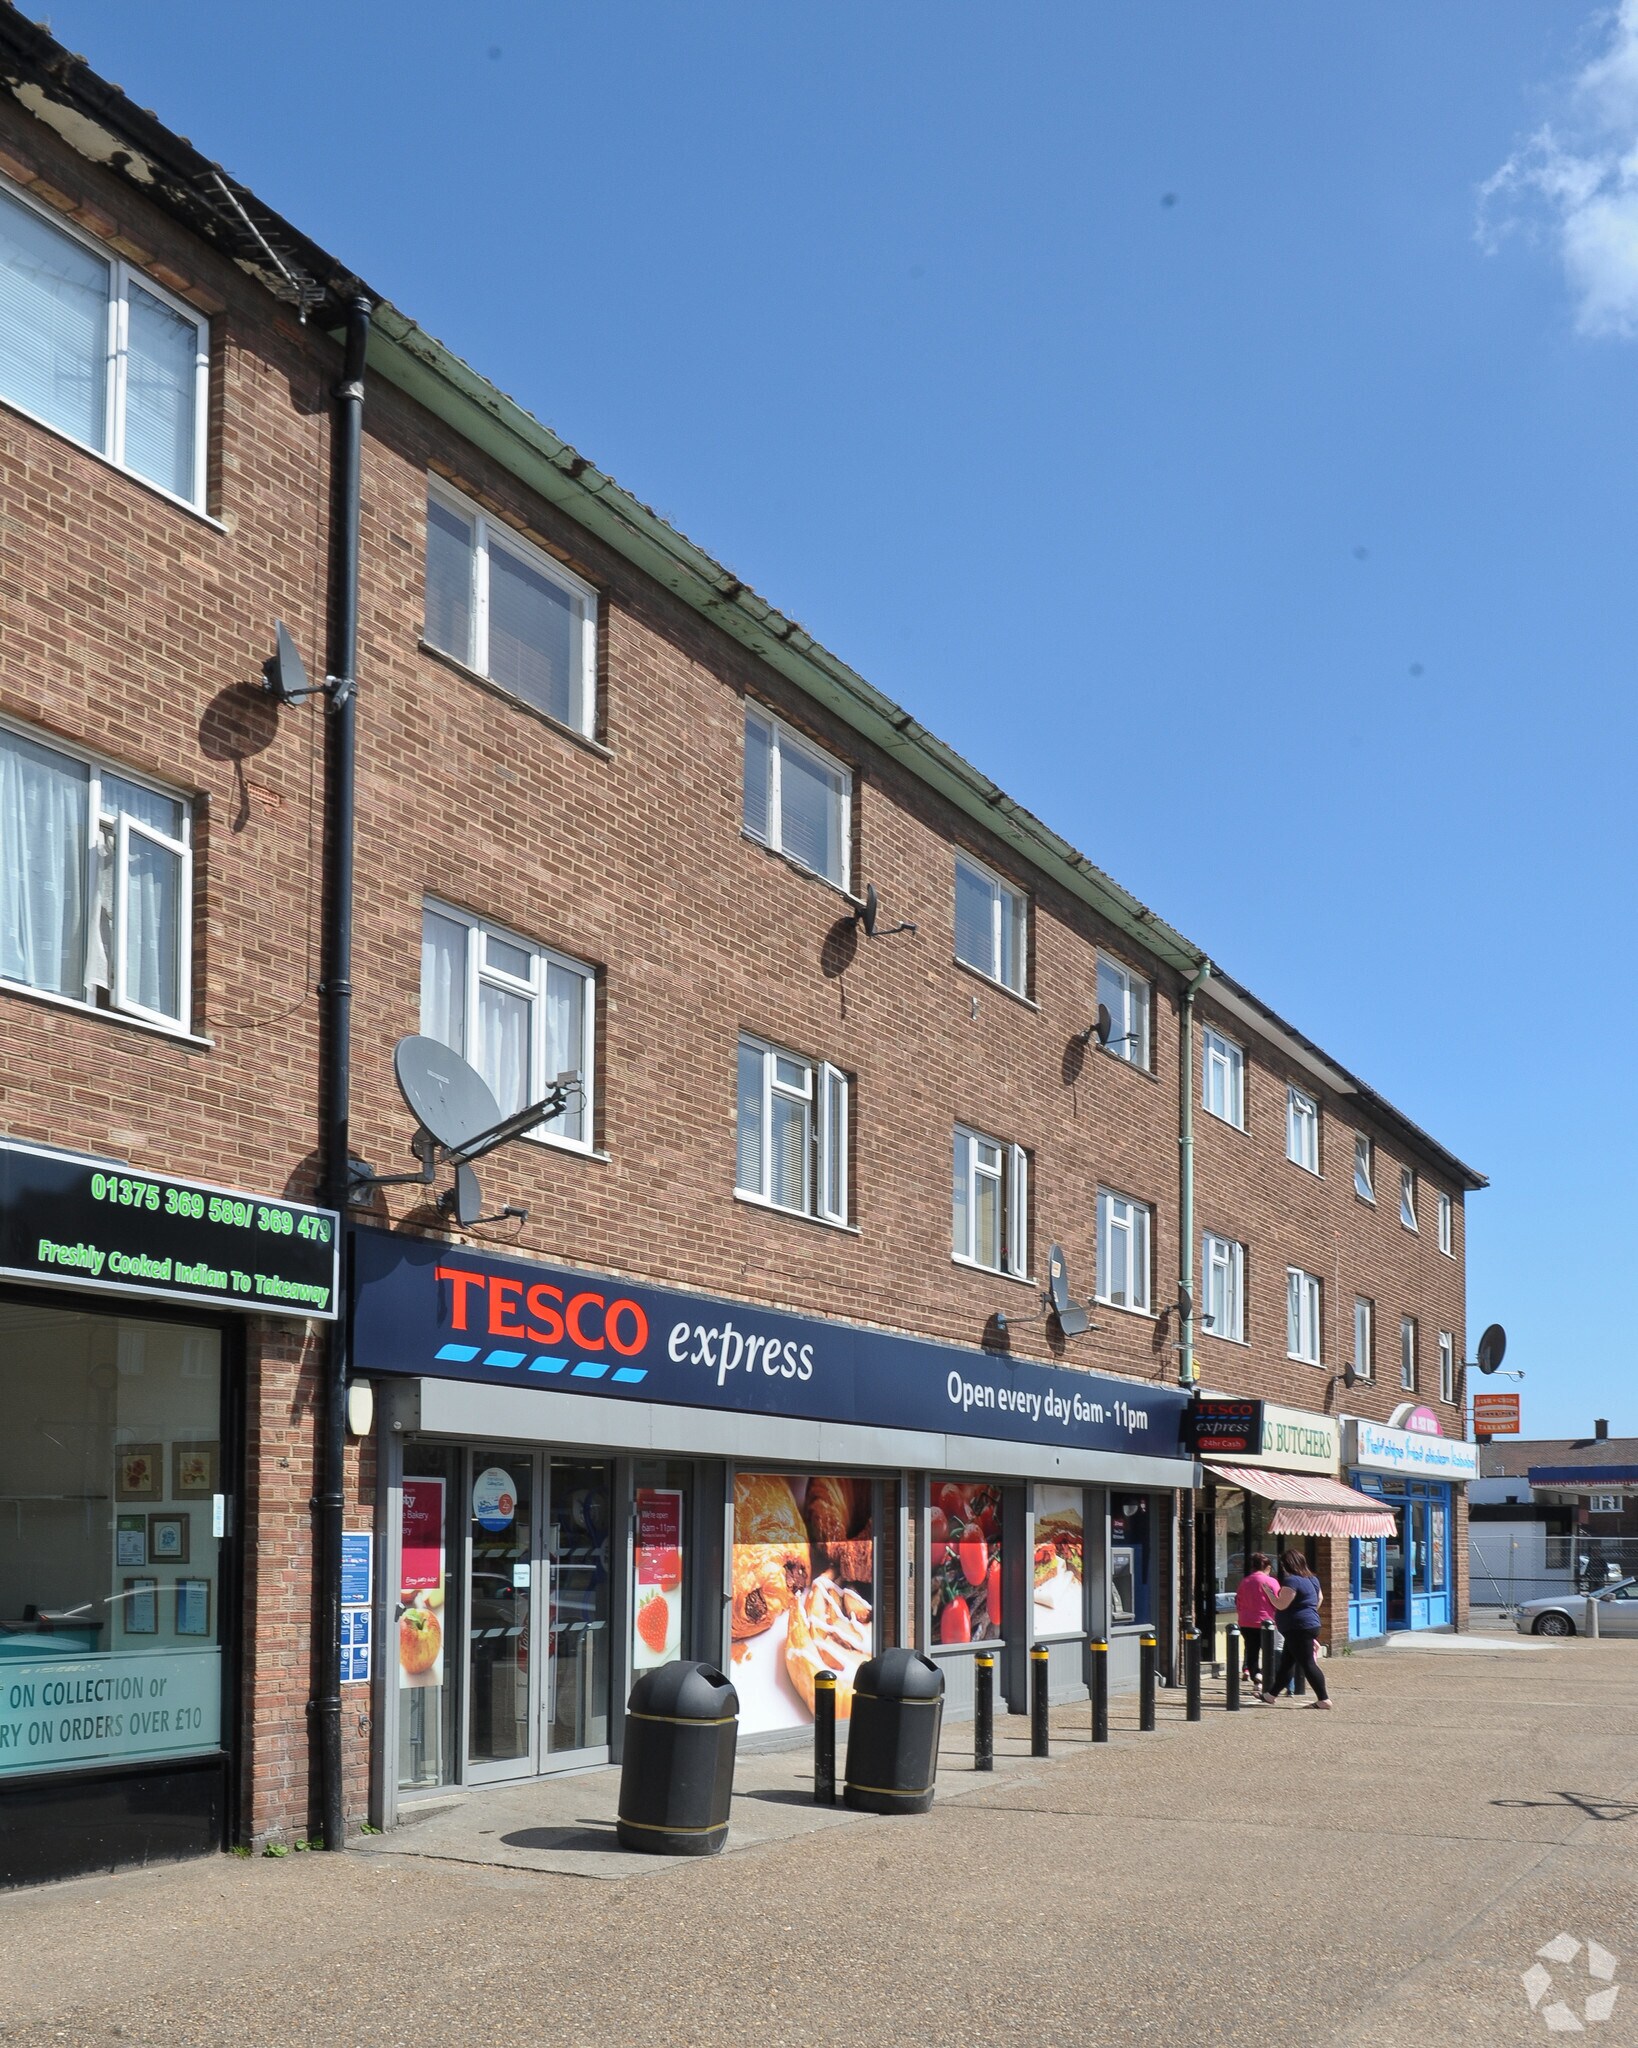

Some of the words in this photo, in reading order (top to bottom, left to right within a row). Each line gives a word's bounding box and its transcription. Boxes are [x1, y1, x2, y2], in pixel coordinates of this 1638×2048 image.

[91, 1173, 159, 1211] 01375
[164, 1188, 204, 1219] 369
[257, 1206, 293, 1235] 369
[298, 1216, 331, 1243] 479
[38, 1239, 105, 1275] Freshly
[108, 1251, 171, 1281] Cooked
[175, 1261, 227, 1289] Indian
[231, 1271, 251, 1293] To
[254, 1273, 330, 1309] Takeaway
[435, 1266, 649, 1356] TESCO
[667, 1321, 814, 1386] express
[947, 1371, 995, 1412] Open
[998, 1389, 1041, 1422] every
[1044, 1388, 1071, 1425] day
[1196, 1404, 1253, 1415] TESCO
[1196, 1422, 1250, 1434] express
[1203, 1439, 1221, 1447] 24hr
[1222, 1439, 1241, 1447] Cash
[1276, 1423, 1332, 1459] BUTCHERS
[407, 1510, 429, 1521] Bakery
[10, 1684, 35, 1709] ON
[42, 1676, 144, 1707] COLLECTION
[150, 1678, 167, 1698] or
[28, 1721, 53, 1745] ON
[59, 1714, 124, 1743] ORDERS
[129, 1710, 169, 1736] OVER
[175, 1707, 202, 1732] £10
